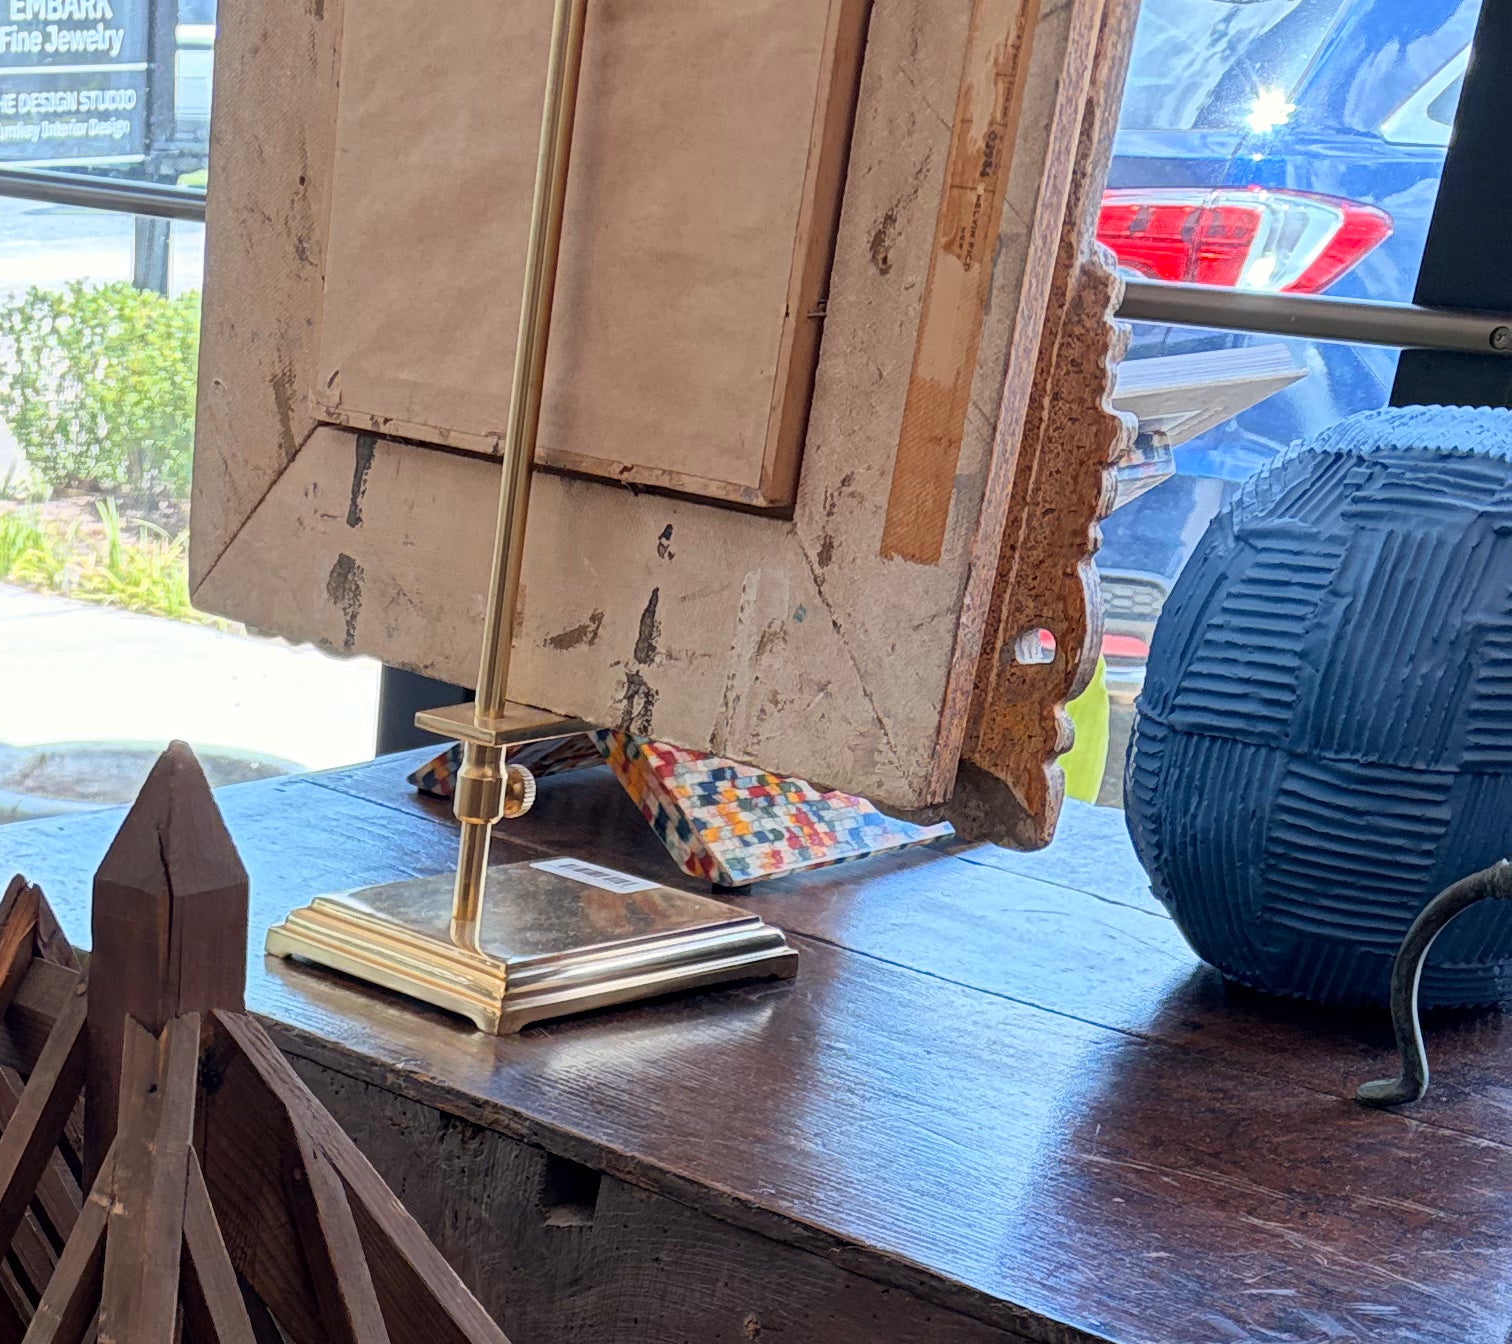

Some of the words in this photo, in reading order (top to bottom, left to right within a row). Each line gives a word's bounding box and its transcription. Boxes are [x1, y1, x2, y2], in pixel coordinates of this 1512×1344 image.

[9, 0, 113, 21] EMBARK
[45, 23, 124, 57] Jewelry
[19, 91, 77, 113] DESIGN
[79, 89, 136, 111] STUDIO
[42, 119, 87, 138] Interior
[89, 117, 130, 139] Design
